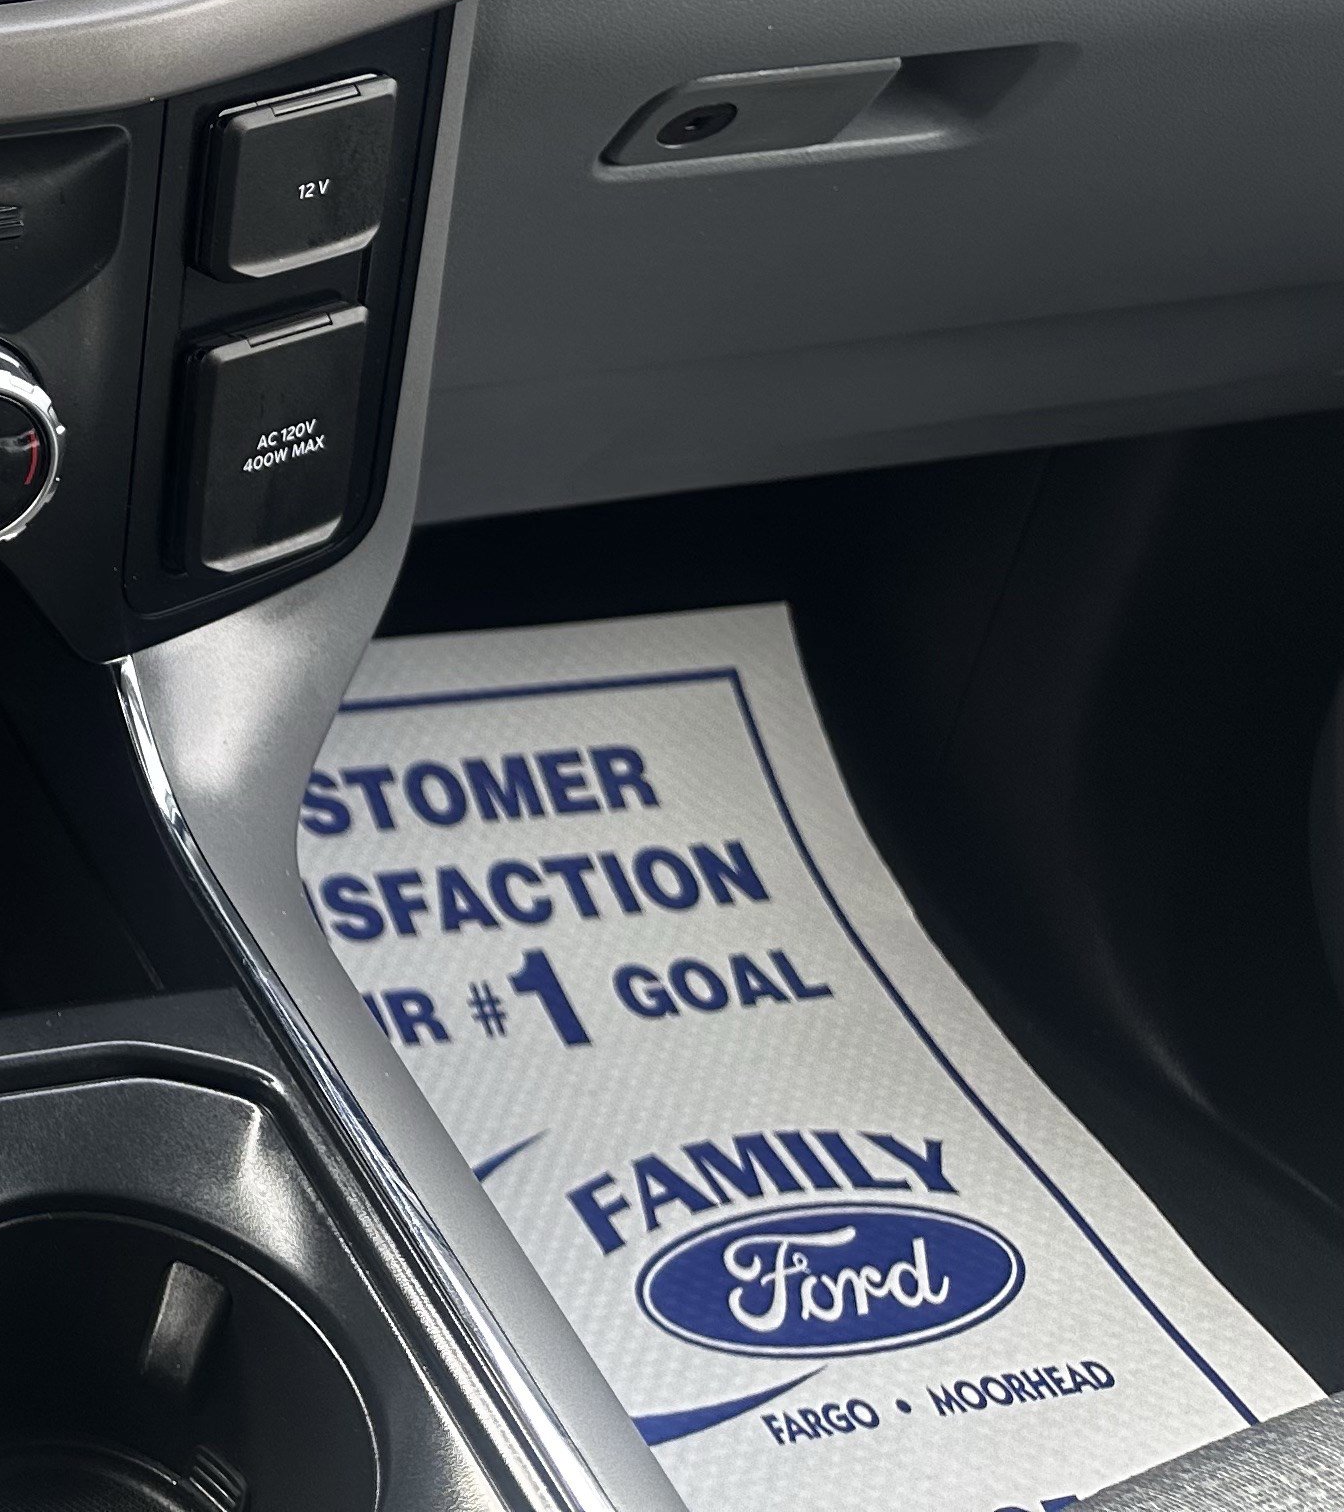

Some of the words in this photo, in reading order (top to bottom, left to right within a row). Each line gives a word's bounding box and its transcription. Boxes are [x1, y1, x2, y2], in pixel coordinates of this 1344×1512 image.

[297, 182, 315, 200] 12
[316, 179, 331, 196] V
[242, 445, 289, 473] 400W
[291, 434, 326, 458] MAX
[256, 431, 279, 451] AC
[279, 419, 317, 441] 120V
[303, 839, 771, 943] SFACTION
[611, 949, 833, 1021] GOAL
[566, 1130, 960, 1256] FAMILY
[723, 1224, 950, 1333] Ford
[761, 1397, 881, 1446] FARGO
[925, 1359, 1116, 1417] MOORHEAD
